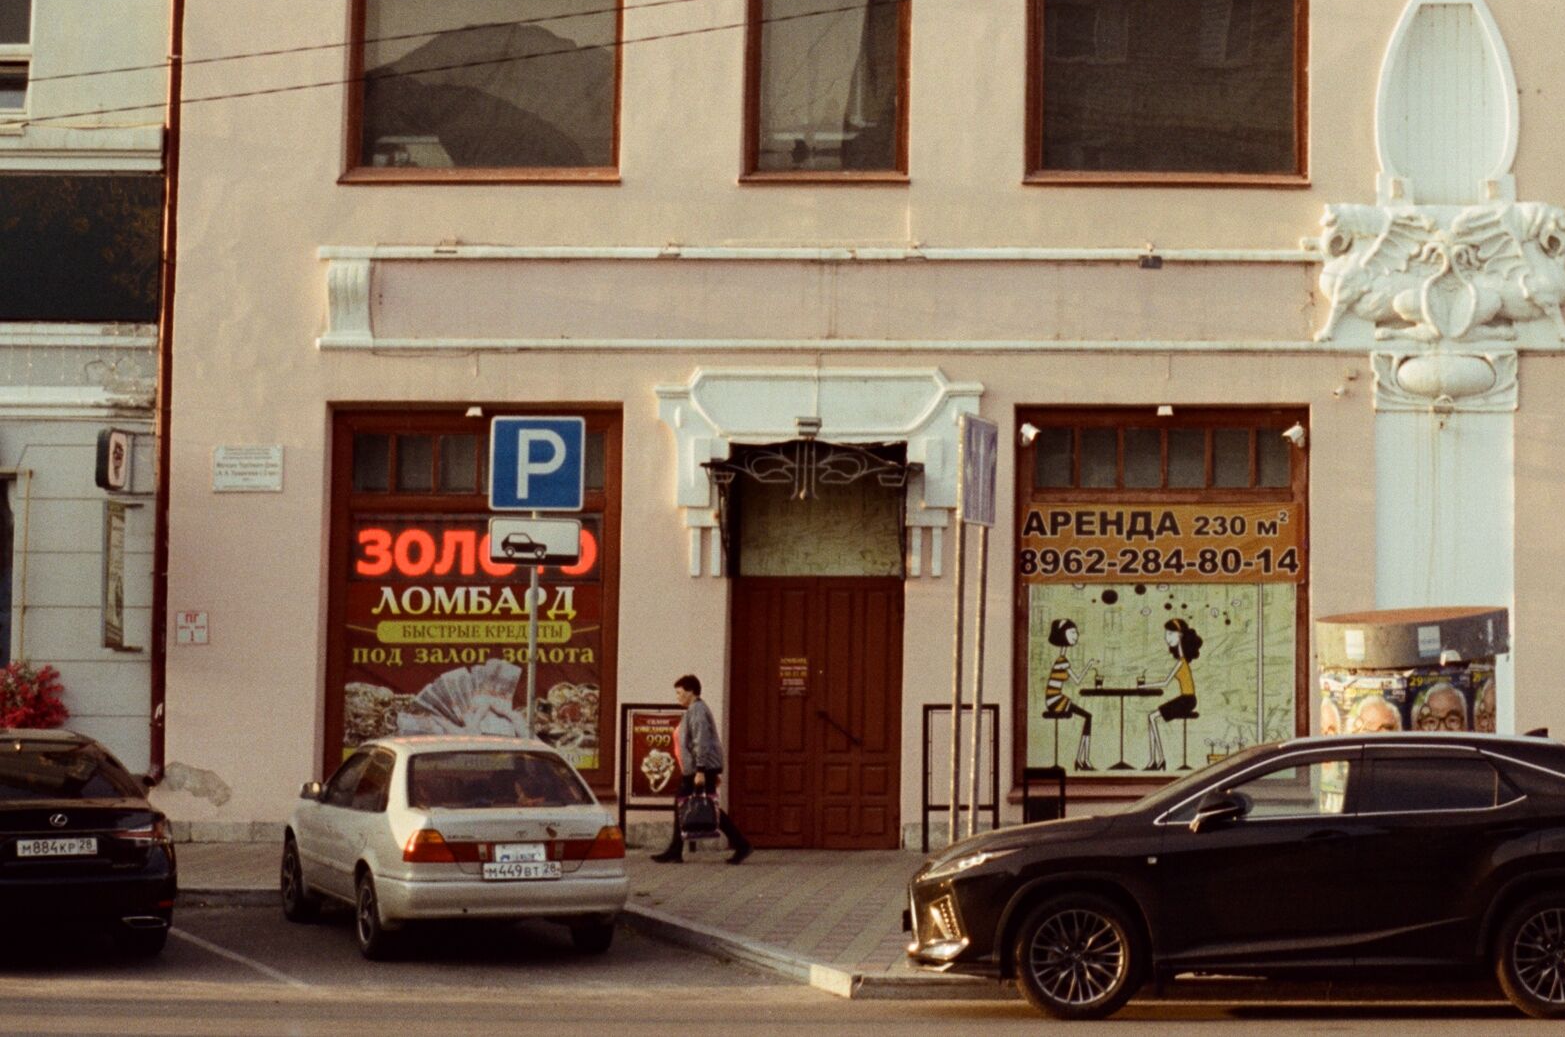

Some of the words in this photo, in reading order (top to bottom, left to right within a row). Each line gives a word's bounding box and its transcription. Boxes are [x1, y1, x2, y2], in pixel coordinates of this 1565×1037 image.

[517, 428, 566, 500] P
[1022, 511, 1180, 541] АРЕНДА
[1193, 516, 1246, 536] 230
[356, 528, 596, 576] ЗОЛО
[1020, 548, 1298, 575] 8962-284-80-14
[372, 586, 577, 620] ЛОМБАРД
[402, 626, 481, 639] БЫСТРЫЕ
[353, 647, 403, 666] под
[415, 647, 491, 664] залог
[646, 734, 671, 746] 999
[79, 839, 93, 851] 28
[543, 863, 557, 873] 28
